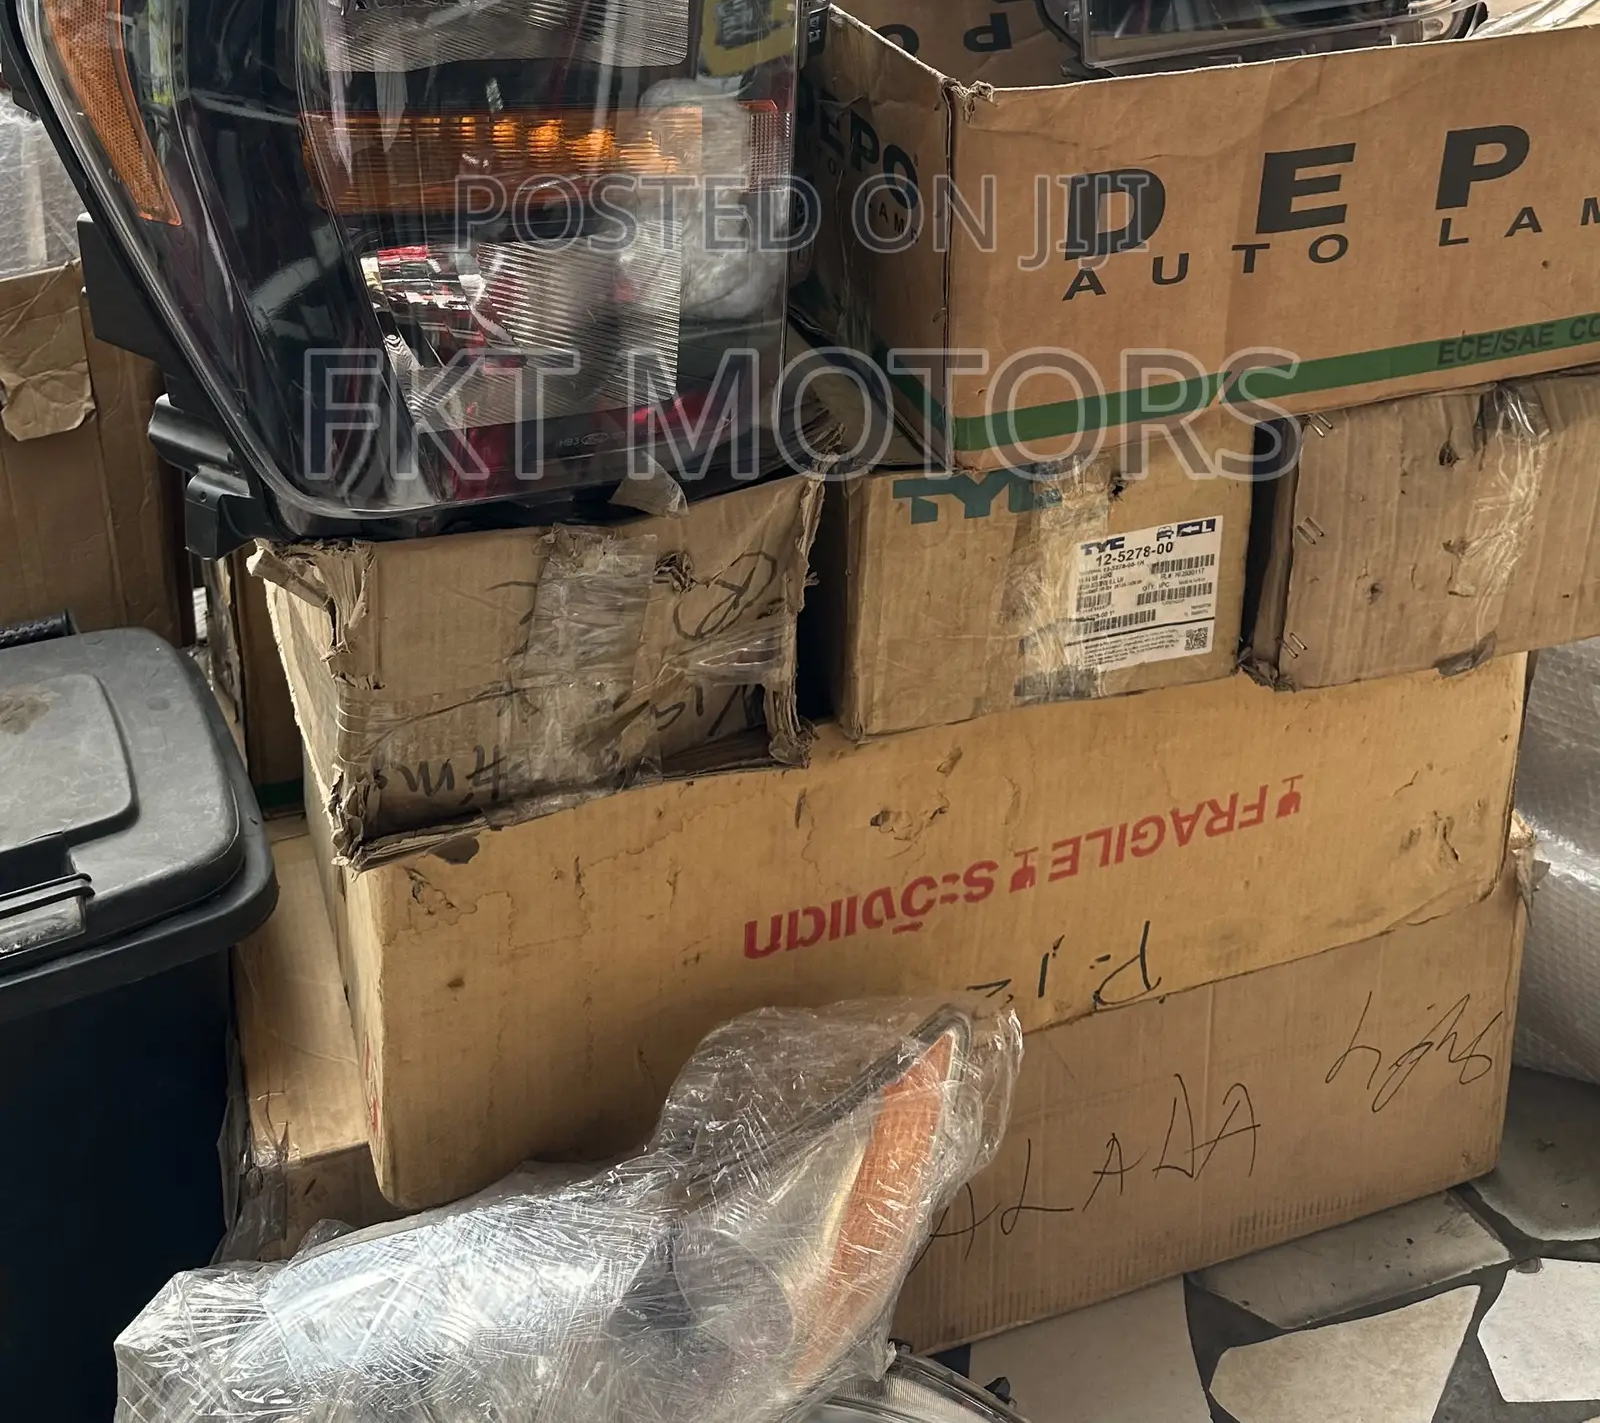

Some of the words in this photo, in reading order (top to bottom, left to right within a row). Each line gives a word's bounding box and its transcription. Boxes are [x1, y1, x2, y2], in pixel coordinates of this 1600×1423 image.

[1062, 233, 1349, 301] AUTO
[1437, 323, 1556, 365] ECE/SAE
[1081, 536, 1125, 556] TYC
[1095, 541, 1174, 567] 12-5278-00
[1048, 784, 1269, 884] FRAGILE
[743, 859, 1000, 960] ระวังแตก
